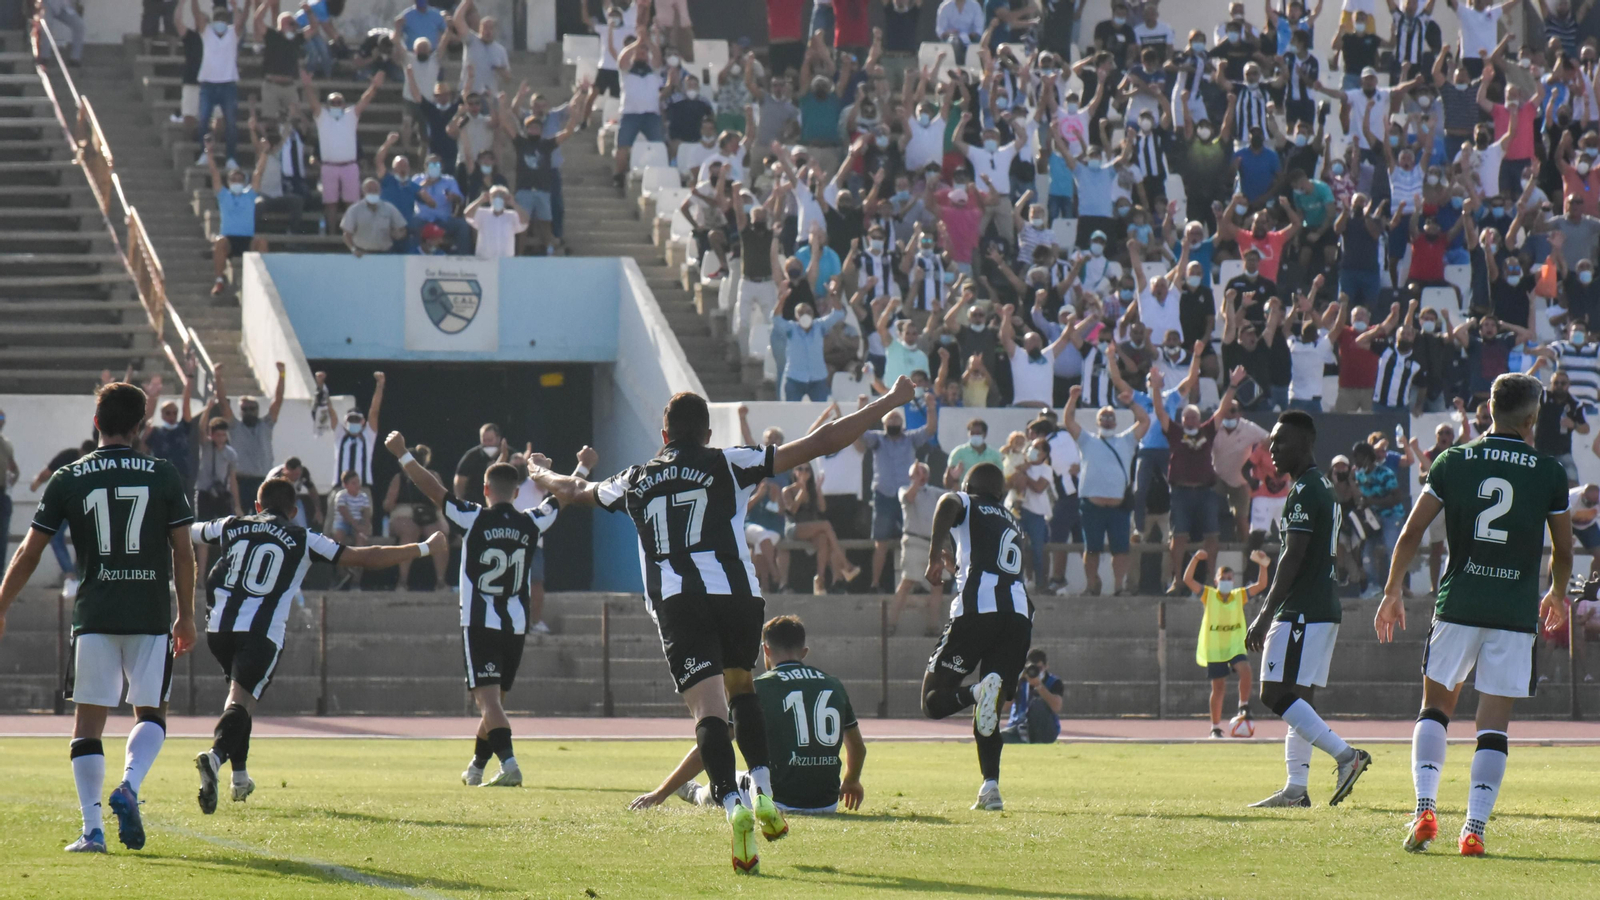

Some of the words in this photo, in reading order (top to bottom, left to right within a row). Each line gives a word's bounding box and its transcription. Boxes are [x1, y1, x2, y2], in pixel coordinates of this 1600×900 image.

[73, 458, 117, 477] SALVA
[121, 458, 155, 473] RUIZ
[634, 465, 678, 499] GERARD
[1465, 448, 1478, 460] D.
[1483, 448, 1538, 468] TORRES
[83, 486, 149, 555] 17
[483, 527, 520, 541] DORRIO
[643, 488, 708, 555] 17
[1474, 477, 1514, 544] 2
[224, 540, 285, 596] 10
[478, 548, 526, 597] 21
[997, 527, 1022, 575] 6
[679, 672, 690, 685] Ruiz
[783, 689, 841, 747] 16
